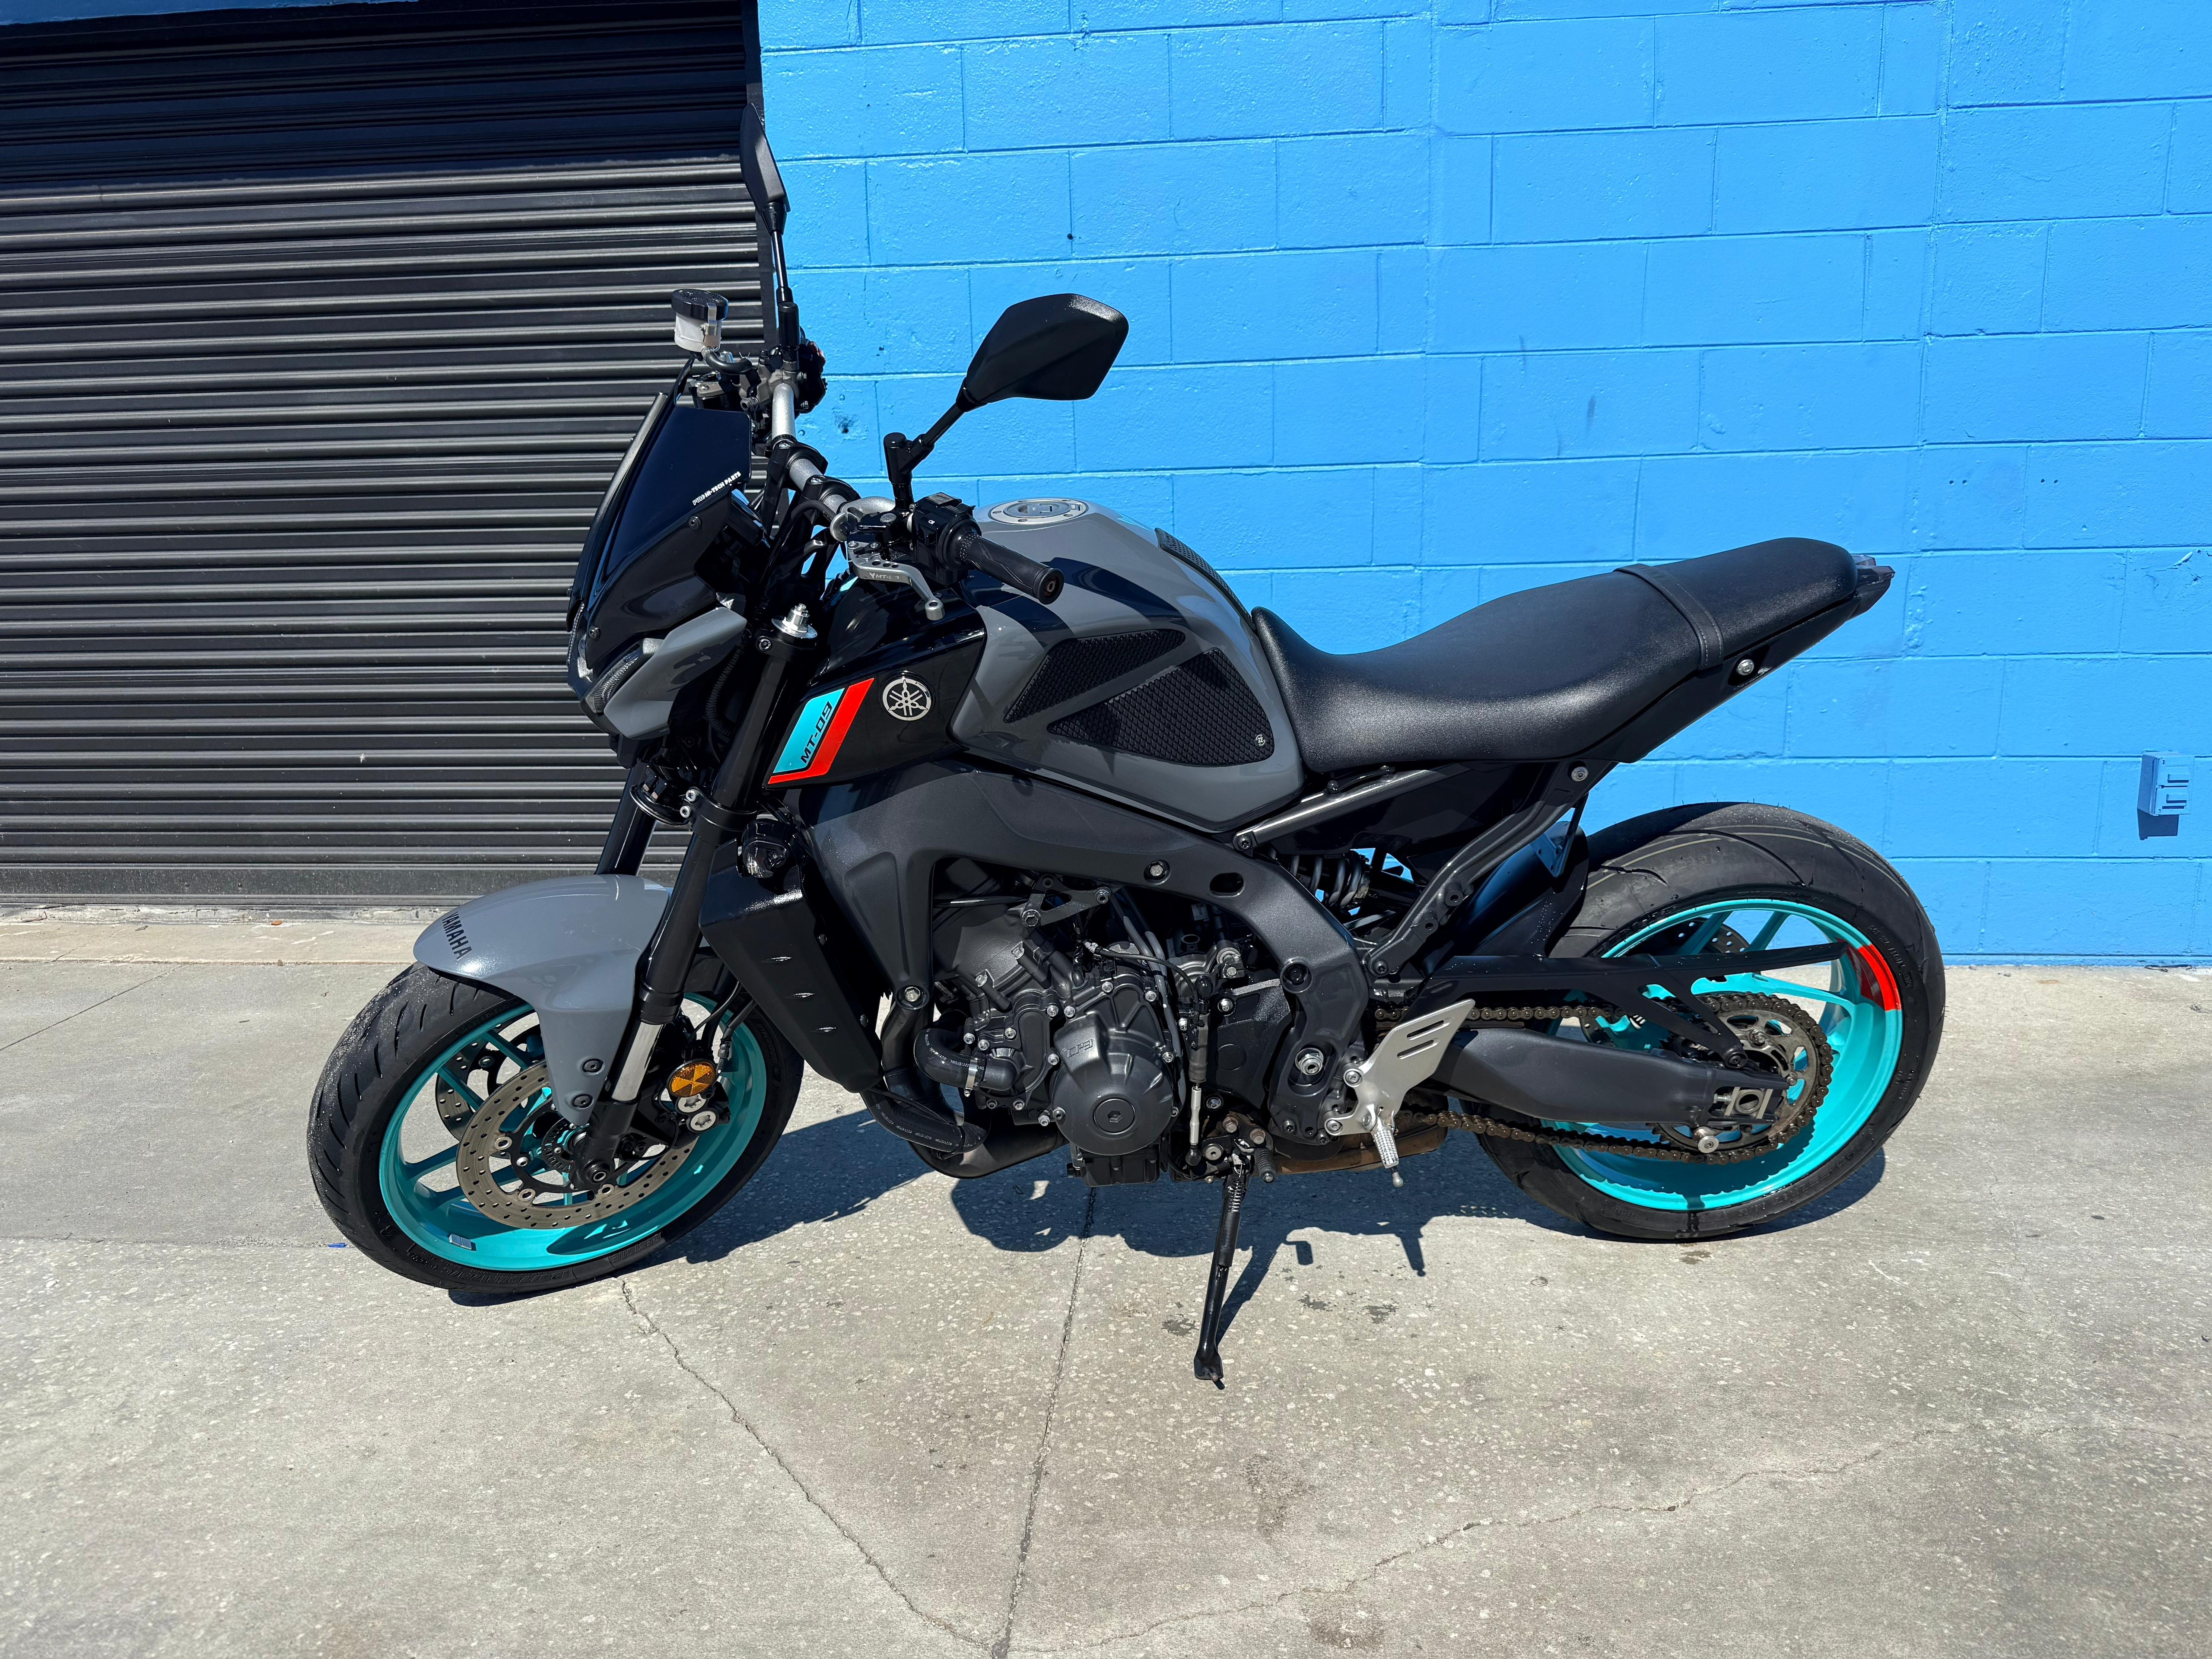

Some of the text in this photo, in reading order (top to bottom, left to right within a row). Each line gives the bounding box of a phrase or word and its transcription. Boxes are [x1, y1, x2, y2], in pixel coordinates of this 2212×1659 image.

[724, 471, 741, 485] PARTS
[800, 701, 833, 764] MT-09
[442, 912, 472, 960] YAMAHA
